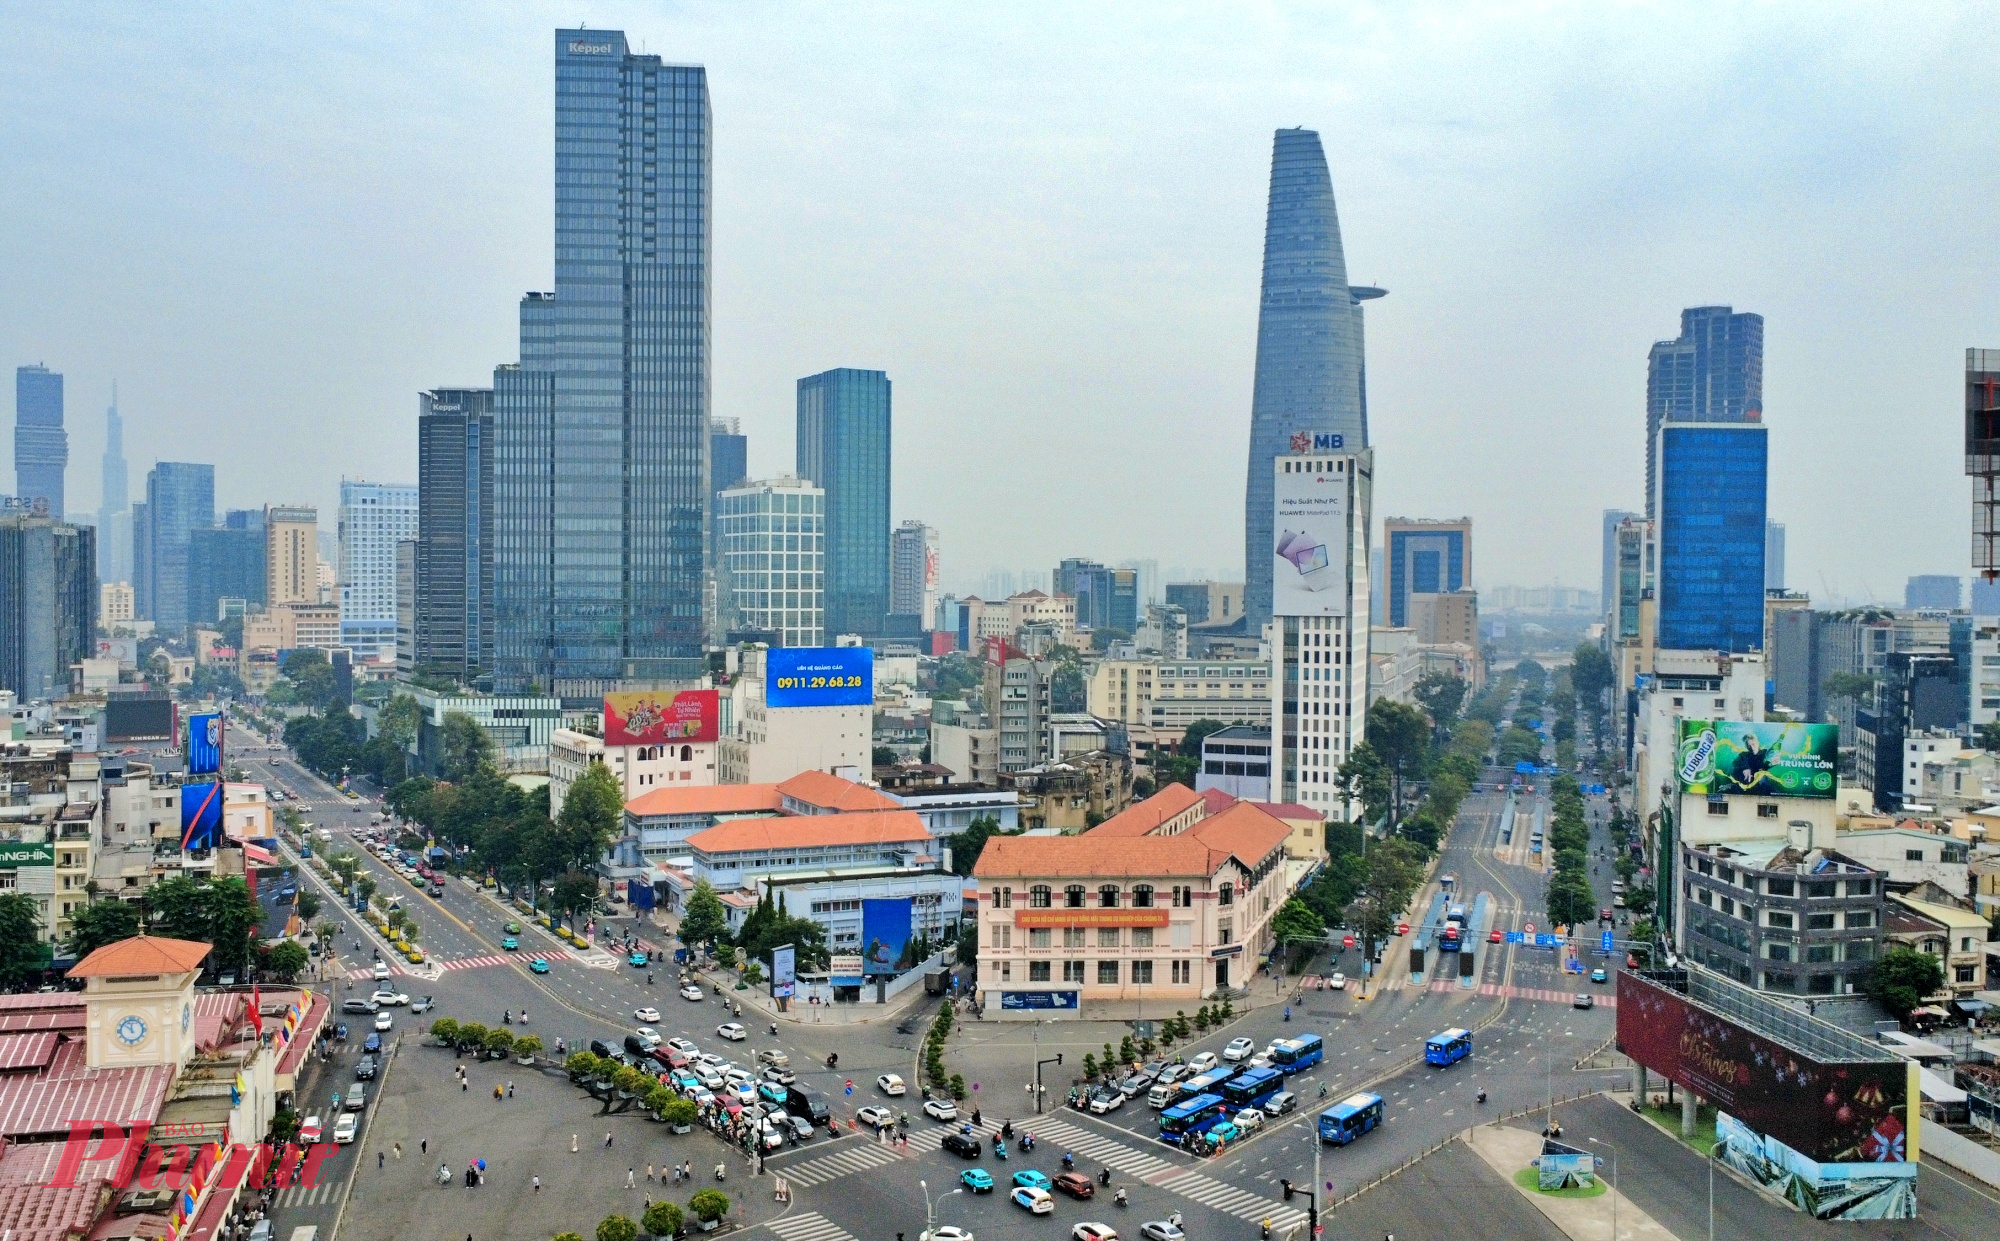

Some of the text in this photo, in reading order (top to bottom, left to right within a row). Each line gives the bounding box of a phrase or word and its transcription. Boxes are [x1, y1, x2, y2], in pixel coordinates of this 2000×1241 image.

[569, 42, 611, 54] Keppel
[433, 403, 460, 412] Keppel
[1314, 434, 1344, 449] MB
[1282, 498, 1297, 506] Hiệu
[777, 676, 862, 689] 0911.29.68.28
[1683, 742, 1712, 778] TUBORG
[1814, 760, 1833, 769] LỚN
